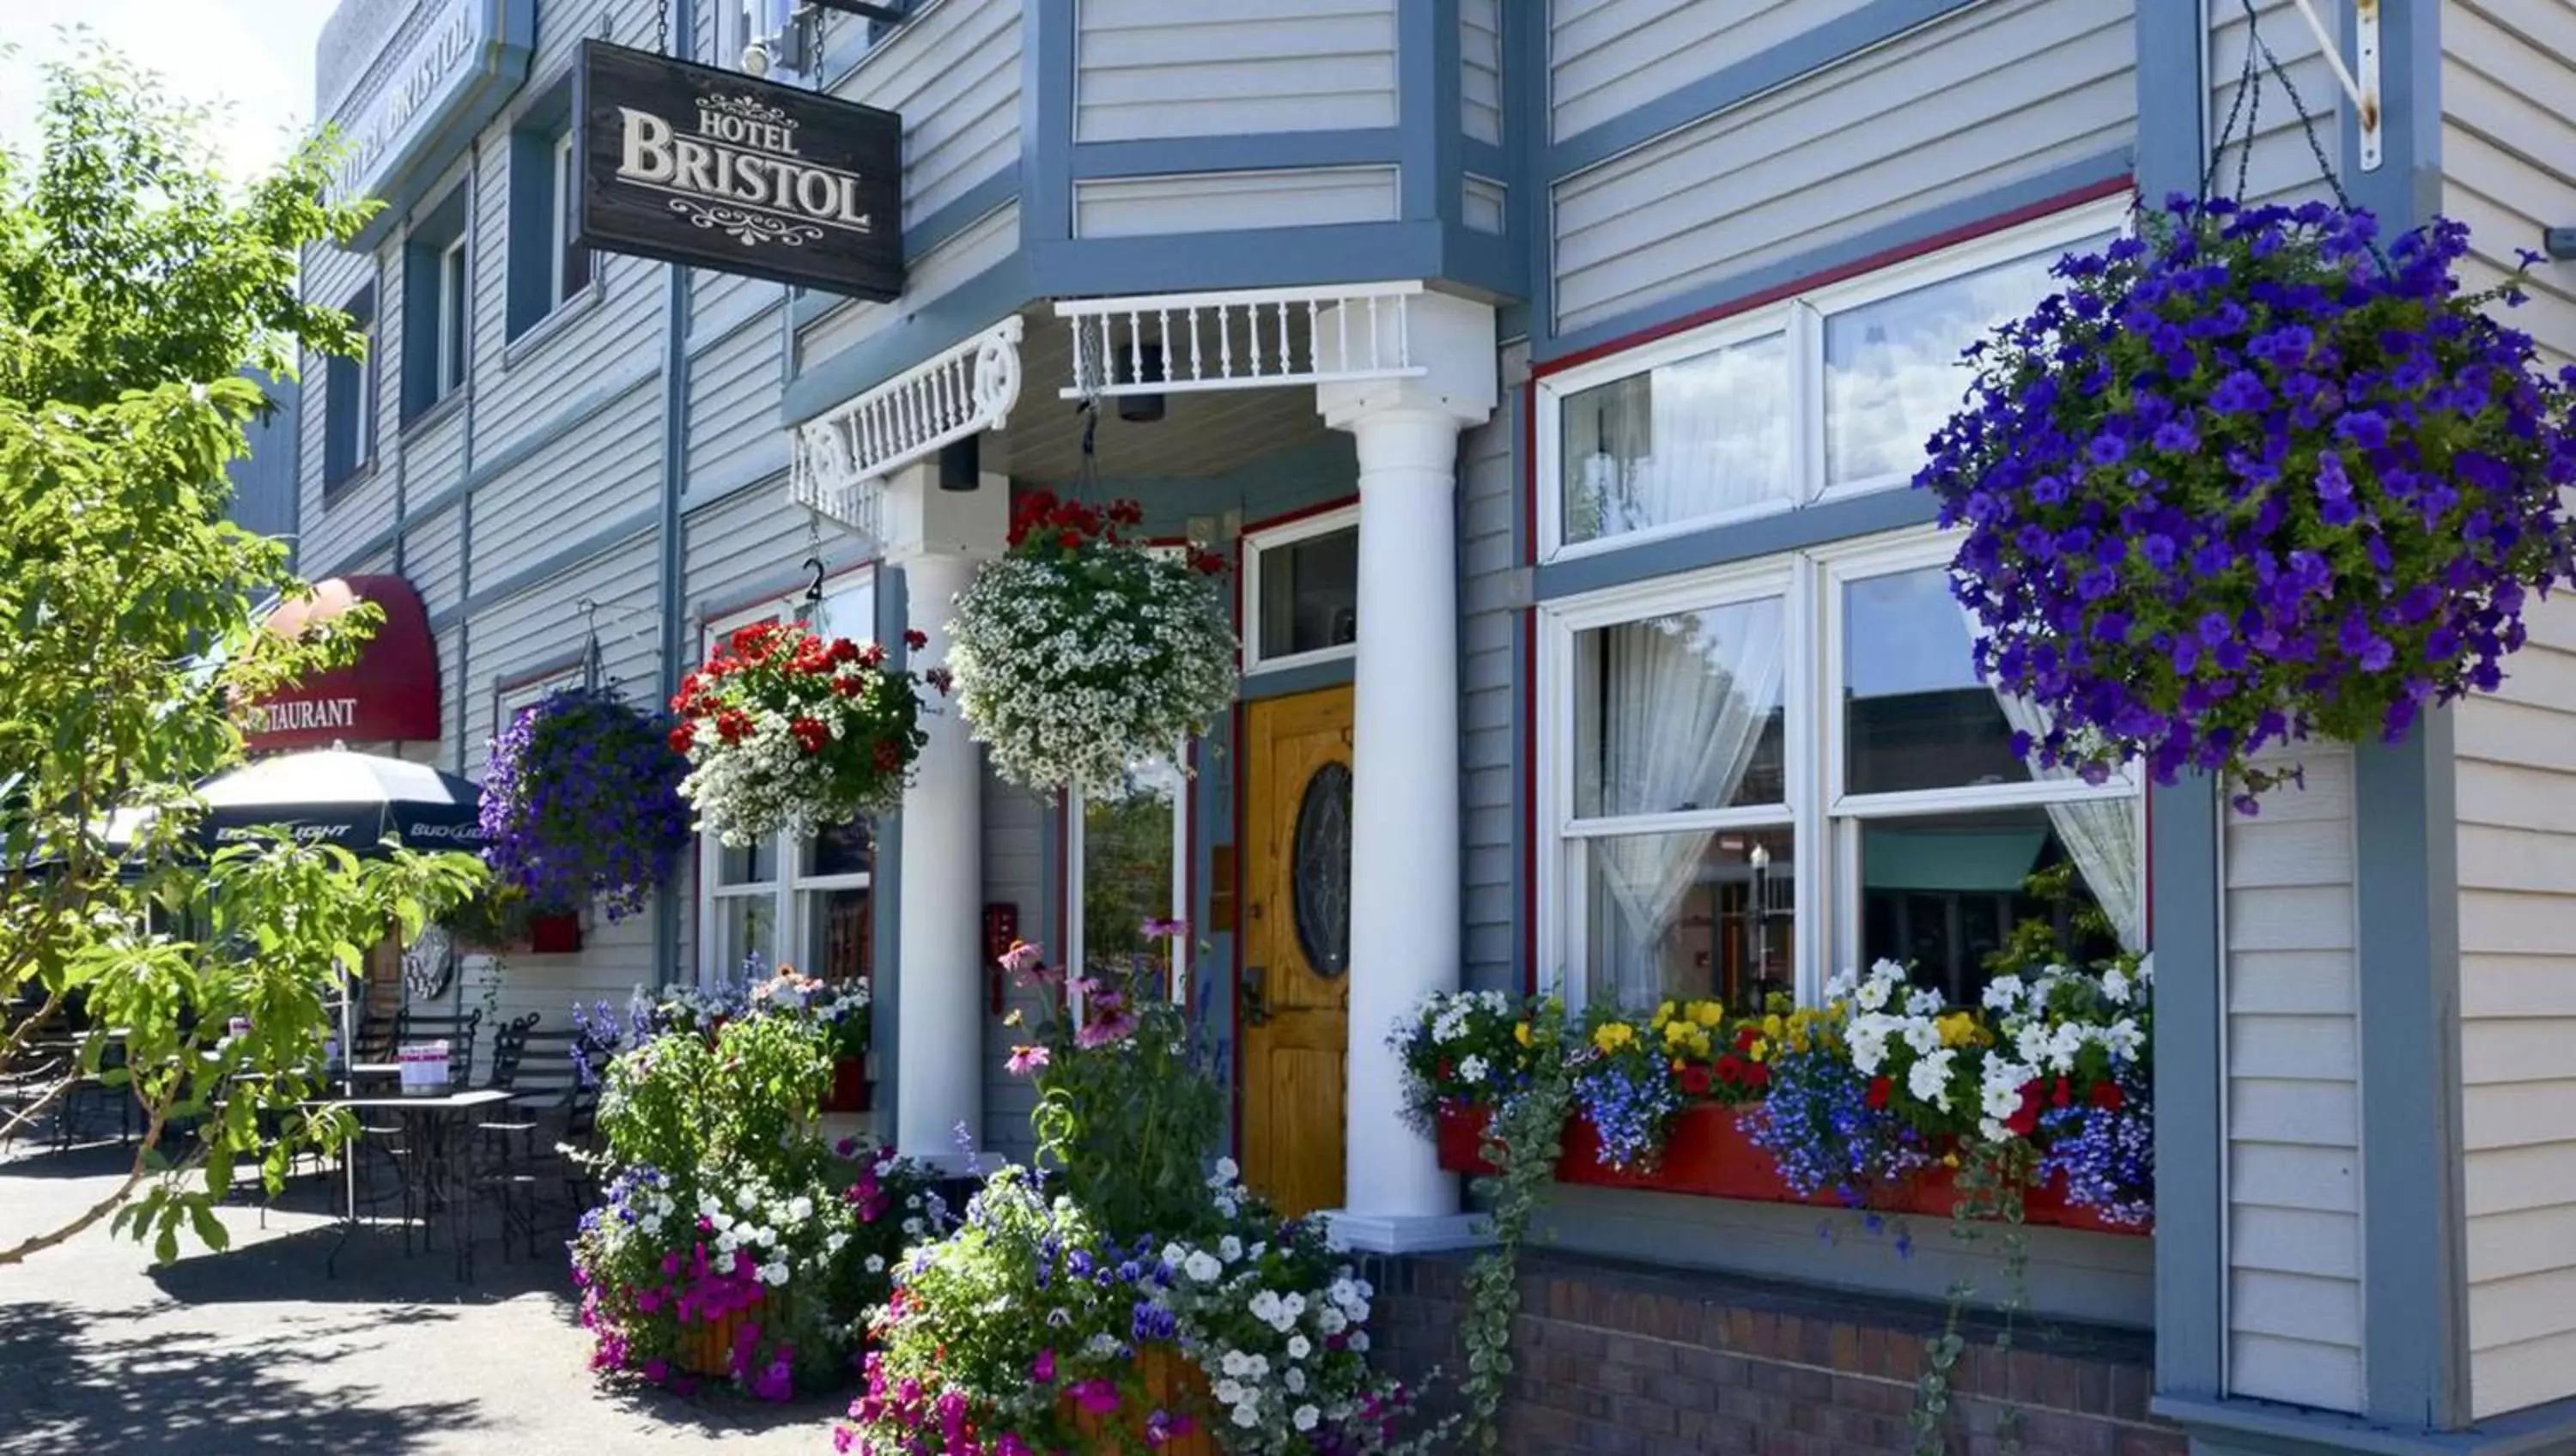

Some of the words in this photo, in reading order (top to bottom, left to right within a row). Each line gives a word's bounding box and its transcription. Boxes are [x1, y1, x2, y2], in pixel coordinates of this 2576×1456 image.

[699, 109, 799, 155] HOTEL
[616, 106, 871, 227] BRISTOL
[232, 699, 357, 732] TAURANT
[410, 823, 449, 837] BUD
